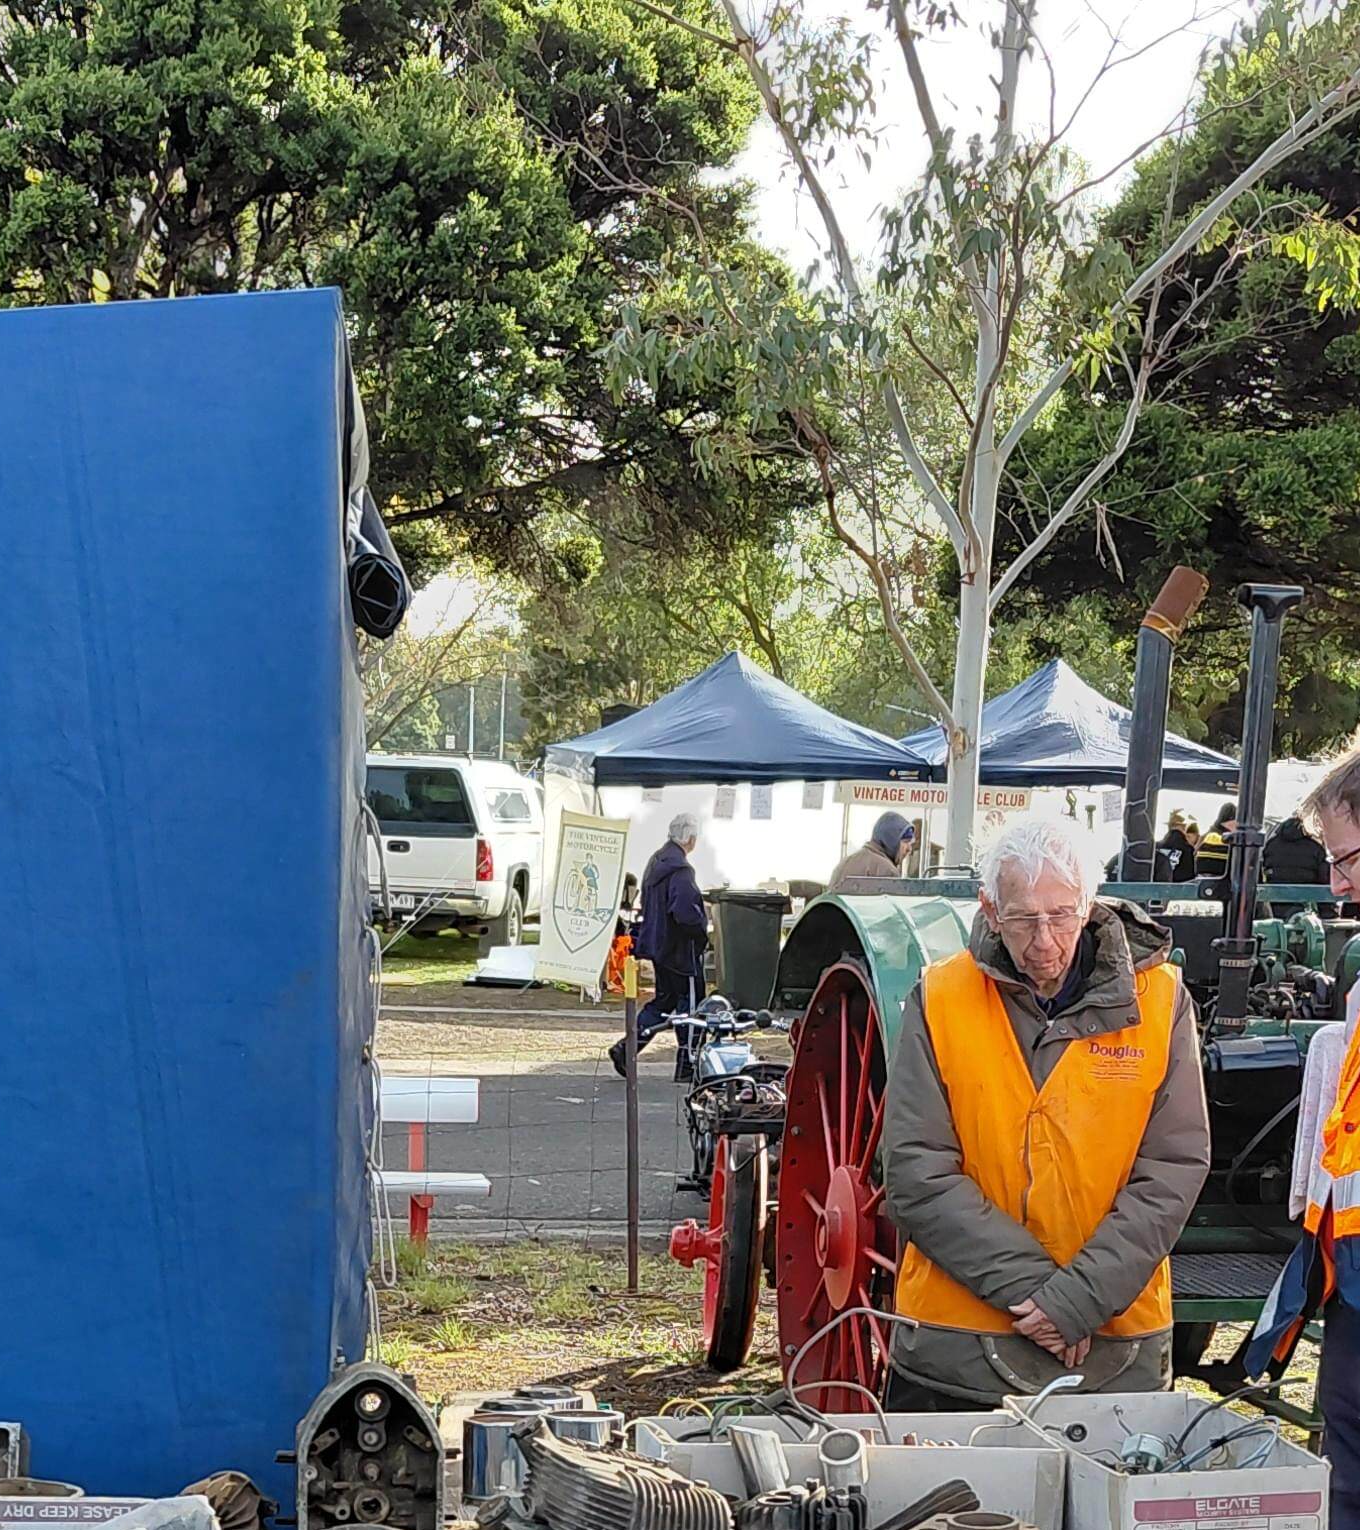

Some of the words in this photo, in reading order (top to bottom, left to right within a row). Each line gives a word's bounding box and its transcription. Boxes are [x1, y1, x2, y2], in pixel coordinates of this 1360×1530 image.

[853, 786, 905, 802] VINTAGE
[910, 789, 990, 806] MOTOLE
[995, 793, 1026, 807] CLUB
[583, 833, 619, 845] VINTAGE
[566, 841, 619, 854] MOTORCYCLE
[1089, 1042, 1145, 1060] Douglas
[1196, 1496, 1261, 1511] ELGATE
[3, 1505, 35, 1518] DRY
[39, 1505, 79, 1518] KEEP
[81, 1505, 134, 1518] LEASE
